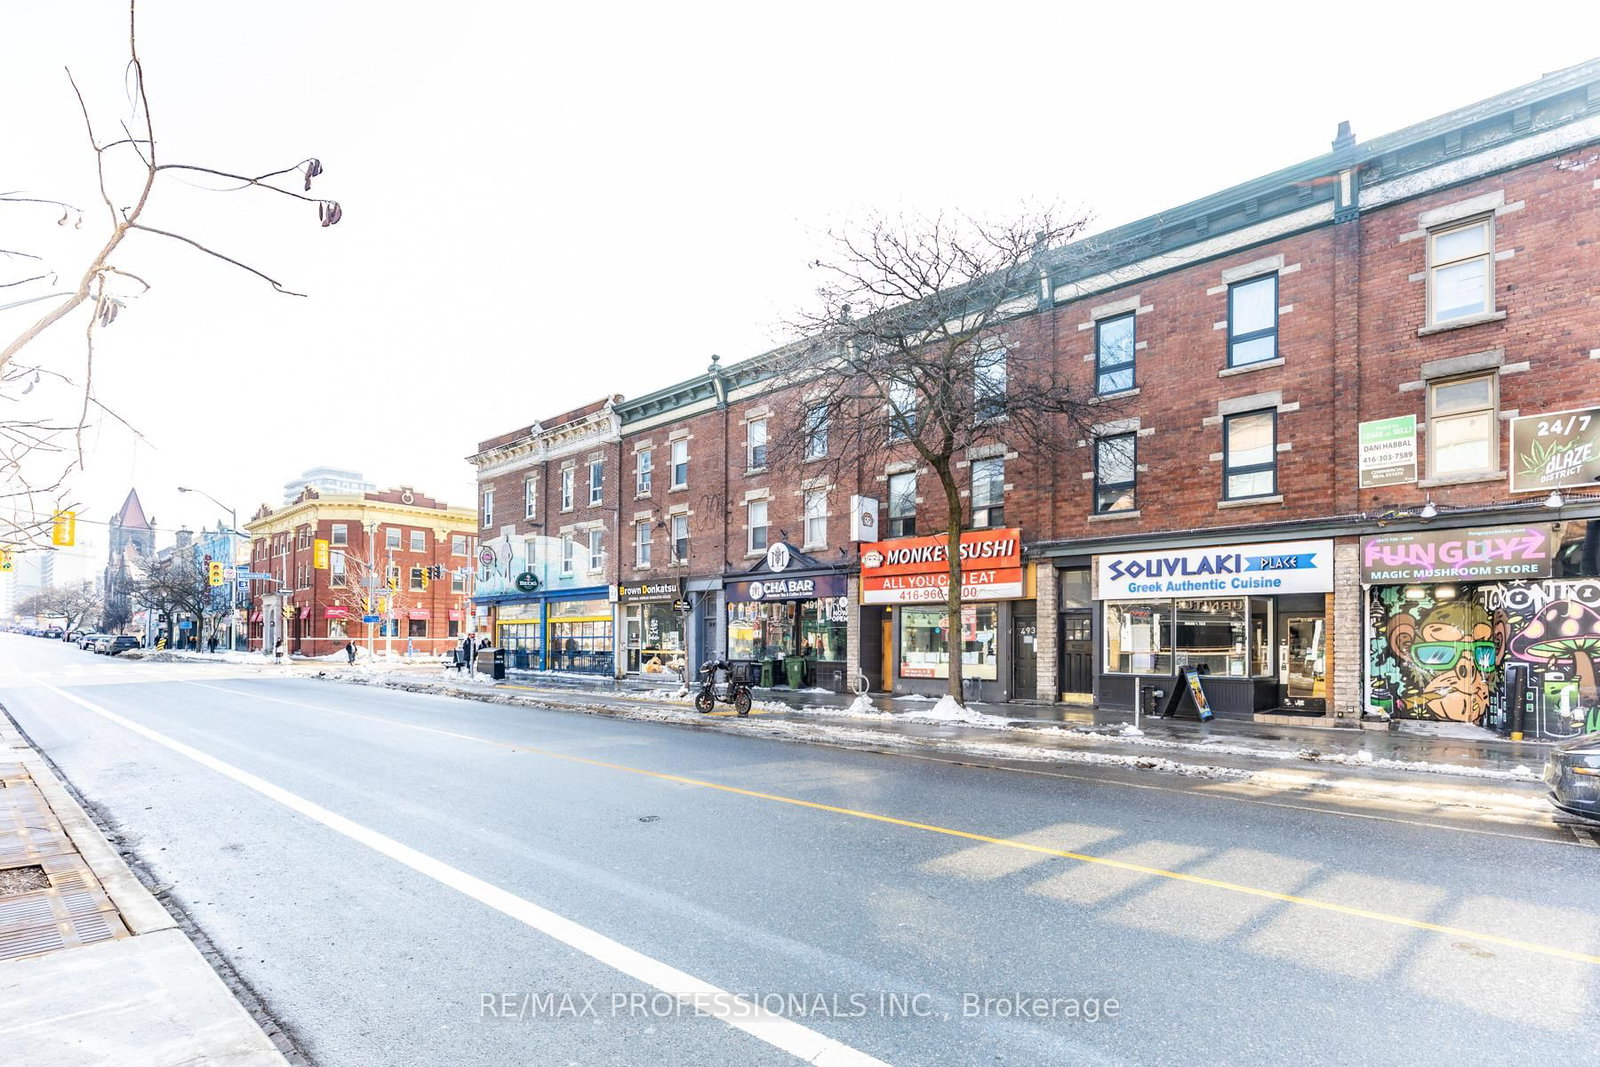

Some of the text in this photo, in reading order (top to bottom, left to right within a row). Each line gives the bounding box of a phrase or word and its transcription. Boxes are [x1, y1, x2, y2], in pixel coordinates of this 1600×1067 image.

[1537, 415, 1592, 437] 24/7
[1363, 440, 1412, 453] DANI HABBAL
[1540, 465, 1583, 484] DISTRICT
[959, 539, 1014, 560] SUSHI
[1364, 535, 1546, 568] FUNGUYZ
[1108, 553, 1297, 581] SOUVLAKI PLACE
[1371, 564, 1539, 580] MAGIC MUSHROOM STORE
[763, 580, 814, 593] CHÁ BAR
[883, 578, 906, 589] ALL
[908, 576, 934, 588] YOU
[970, 571, 997, 584] EAT
[1127, 577, 1282, 593] Greek Authentic Cuisine
[620, 584, 677, 596] Brown Donkatsu
[1020, 626, 1036, 635] 493
